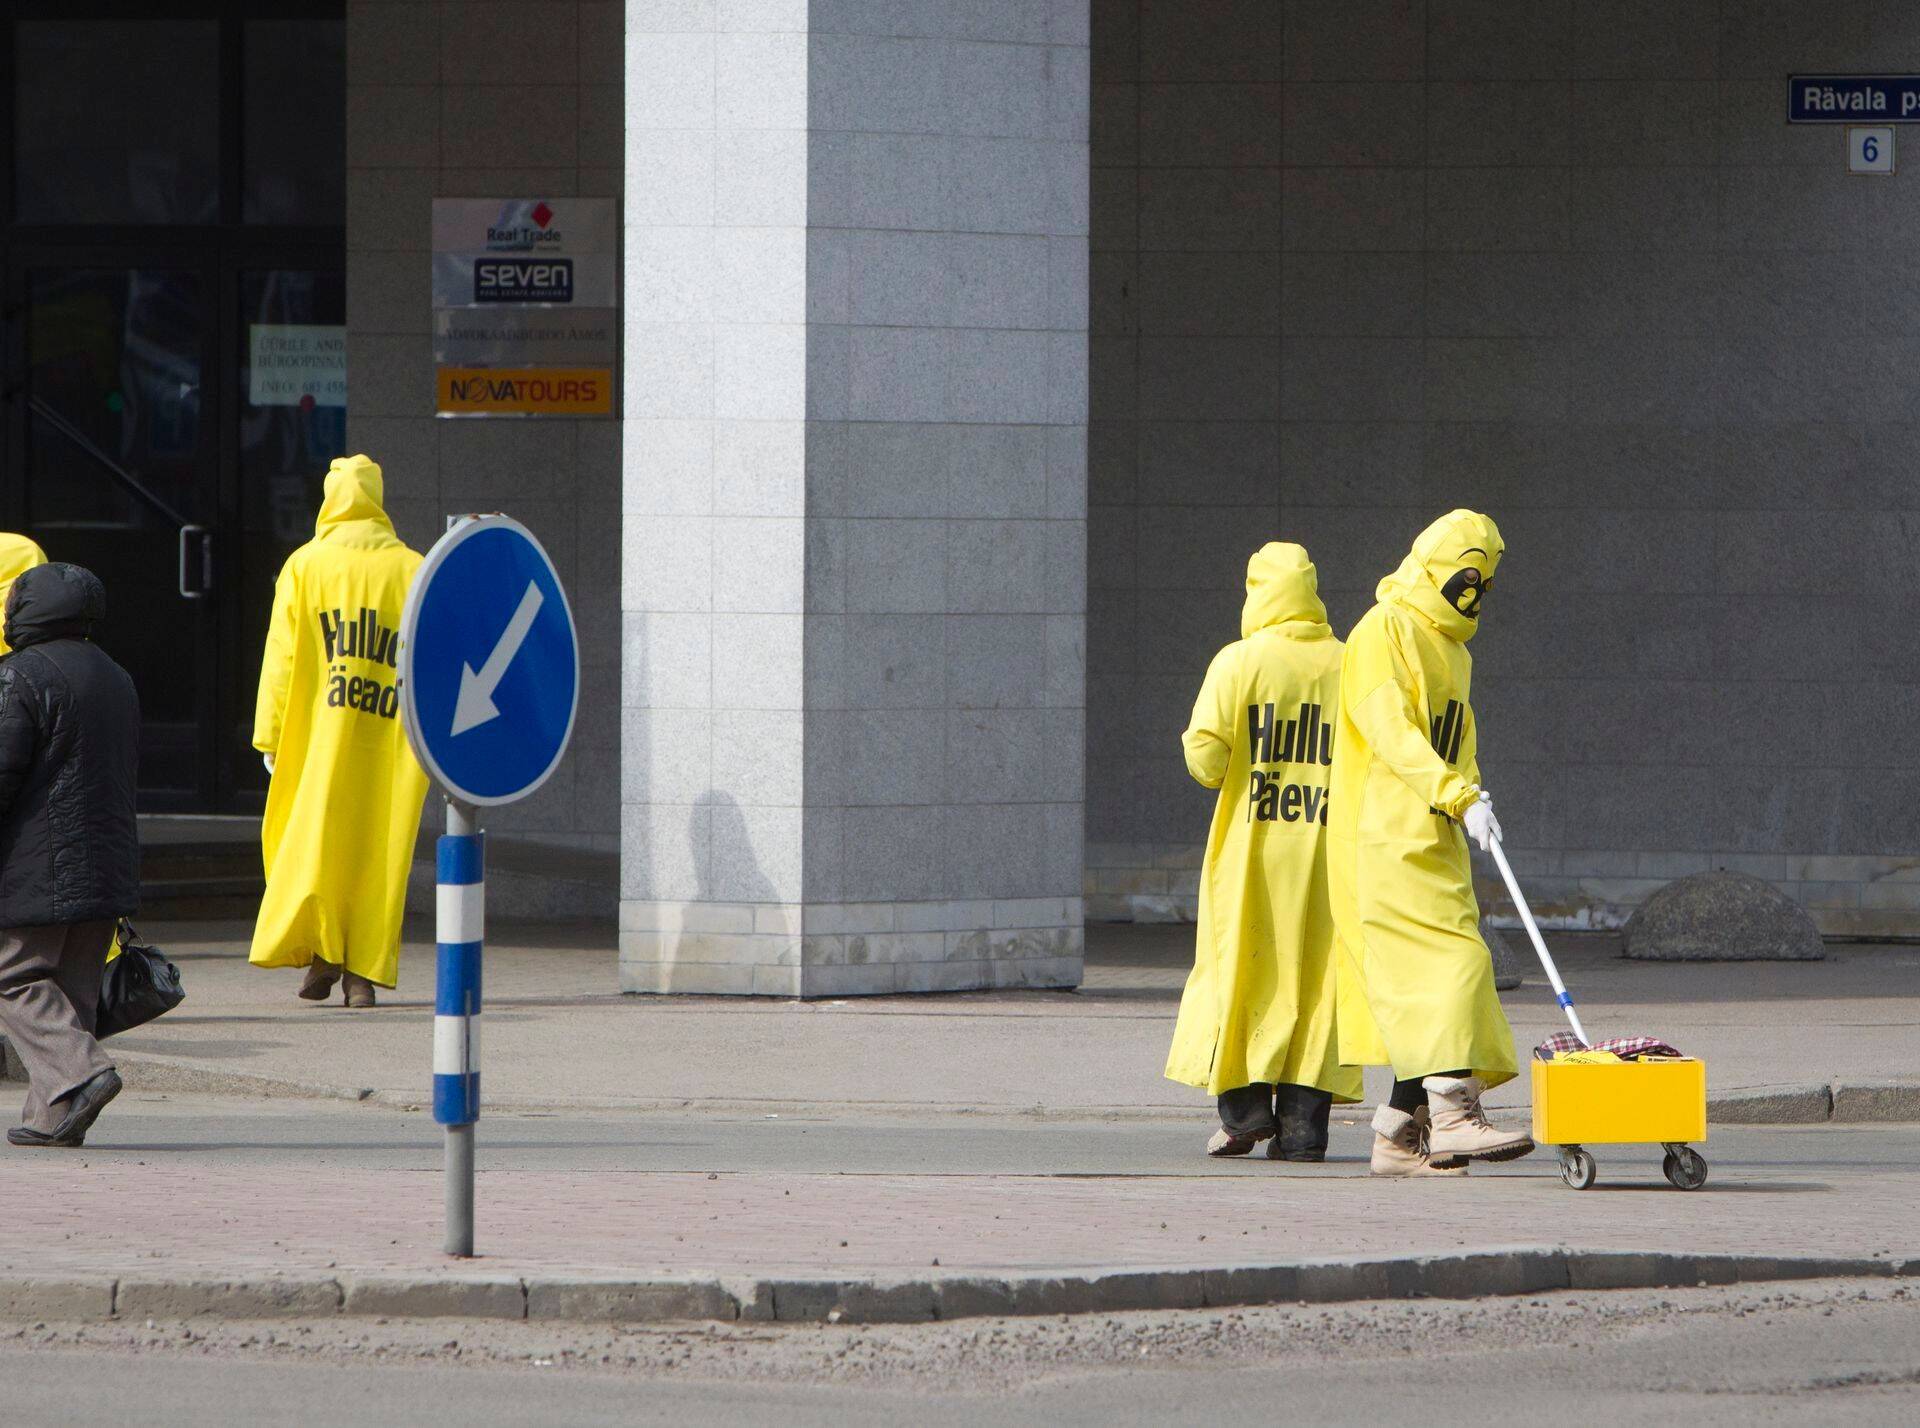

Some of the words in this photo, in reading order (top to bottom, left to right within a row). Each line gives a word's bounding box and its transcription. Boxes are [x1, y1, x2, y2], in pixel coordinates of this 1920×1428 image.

[1804, 86, 1887, 110] Rävala
[1901, 90, 1920, 116] p
[1863, 136, 1878, 162] 6
[487, 228, 517, 242] Real
[520, 228, 561, 242] Trade
[480, 264, 568, 287] seven
[314, 338, 346, 352] AND
[451, 377, 597, 403] NOVATOURS
